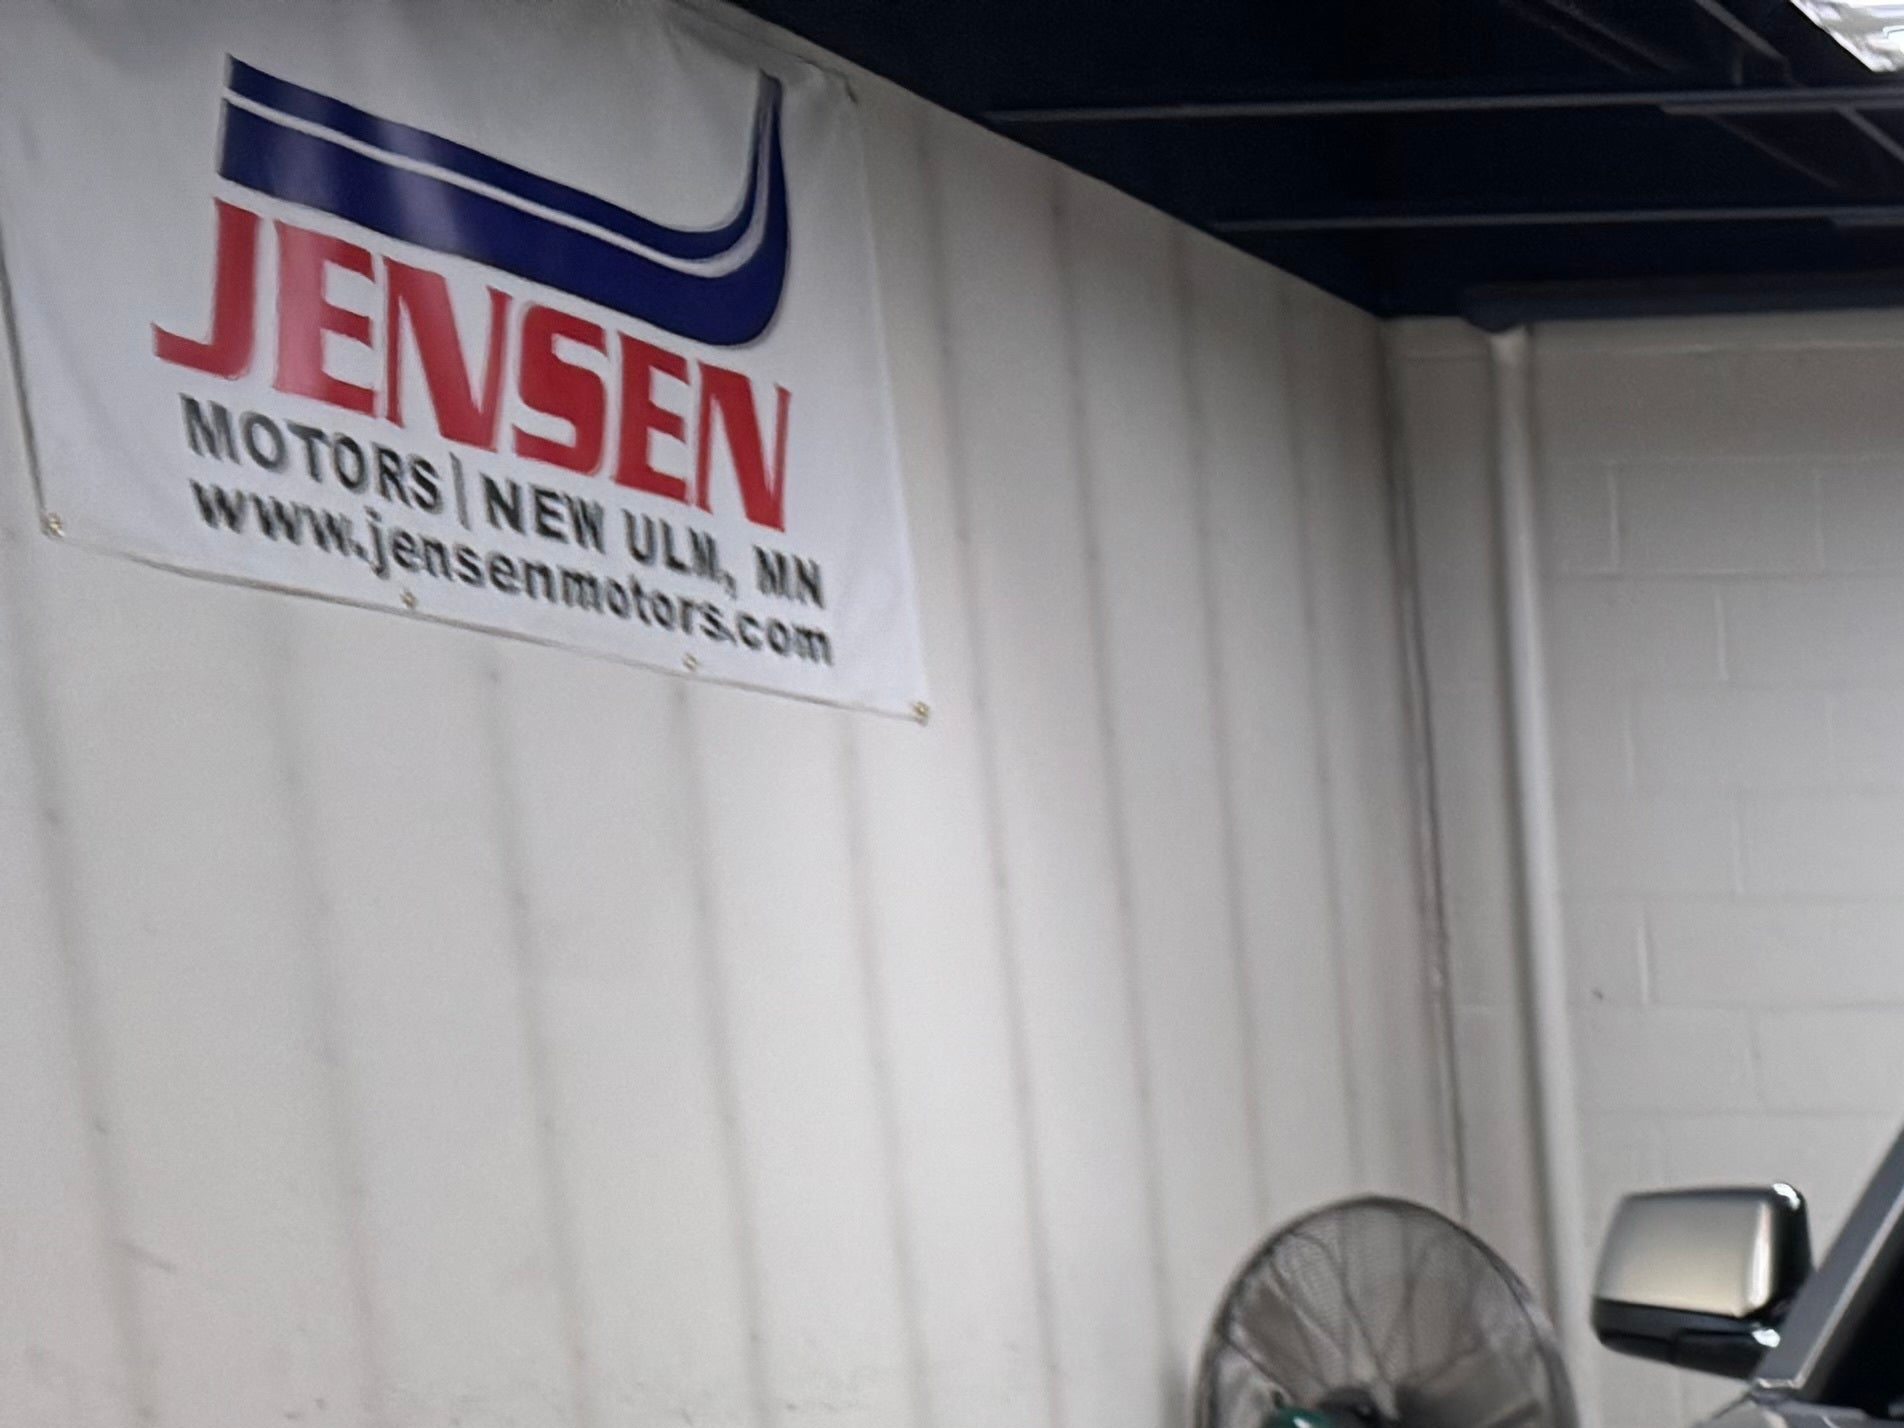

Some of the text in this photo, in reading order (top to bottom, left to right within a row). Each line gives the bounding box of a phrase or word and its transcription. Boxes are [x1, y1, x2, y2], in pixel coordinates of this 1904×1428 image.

[151, 196, 793, 533] JENSEN
[179, 393, 828, 610] MOTORS NEW ULM, MN
[190, 480, 833, 666] www.jensenmotors.com
